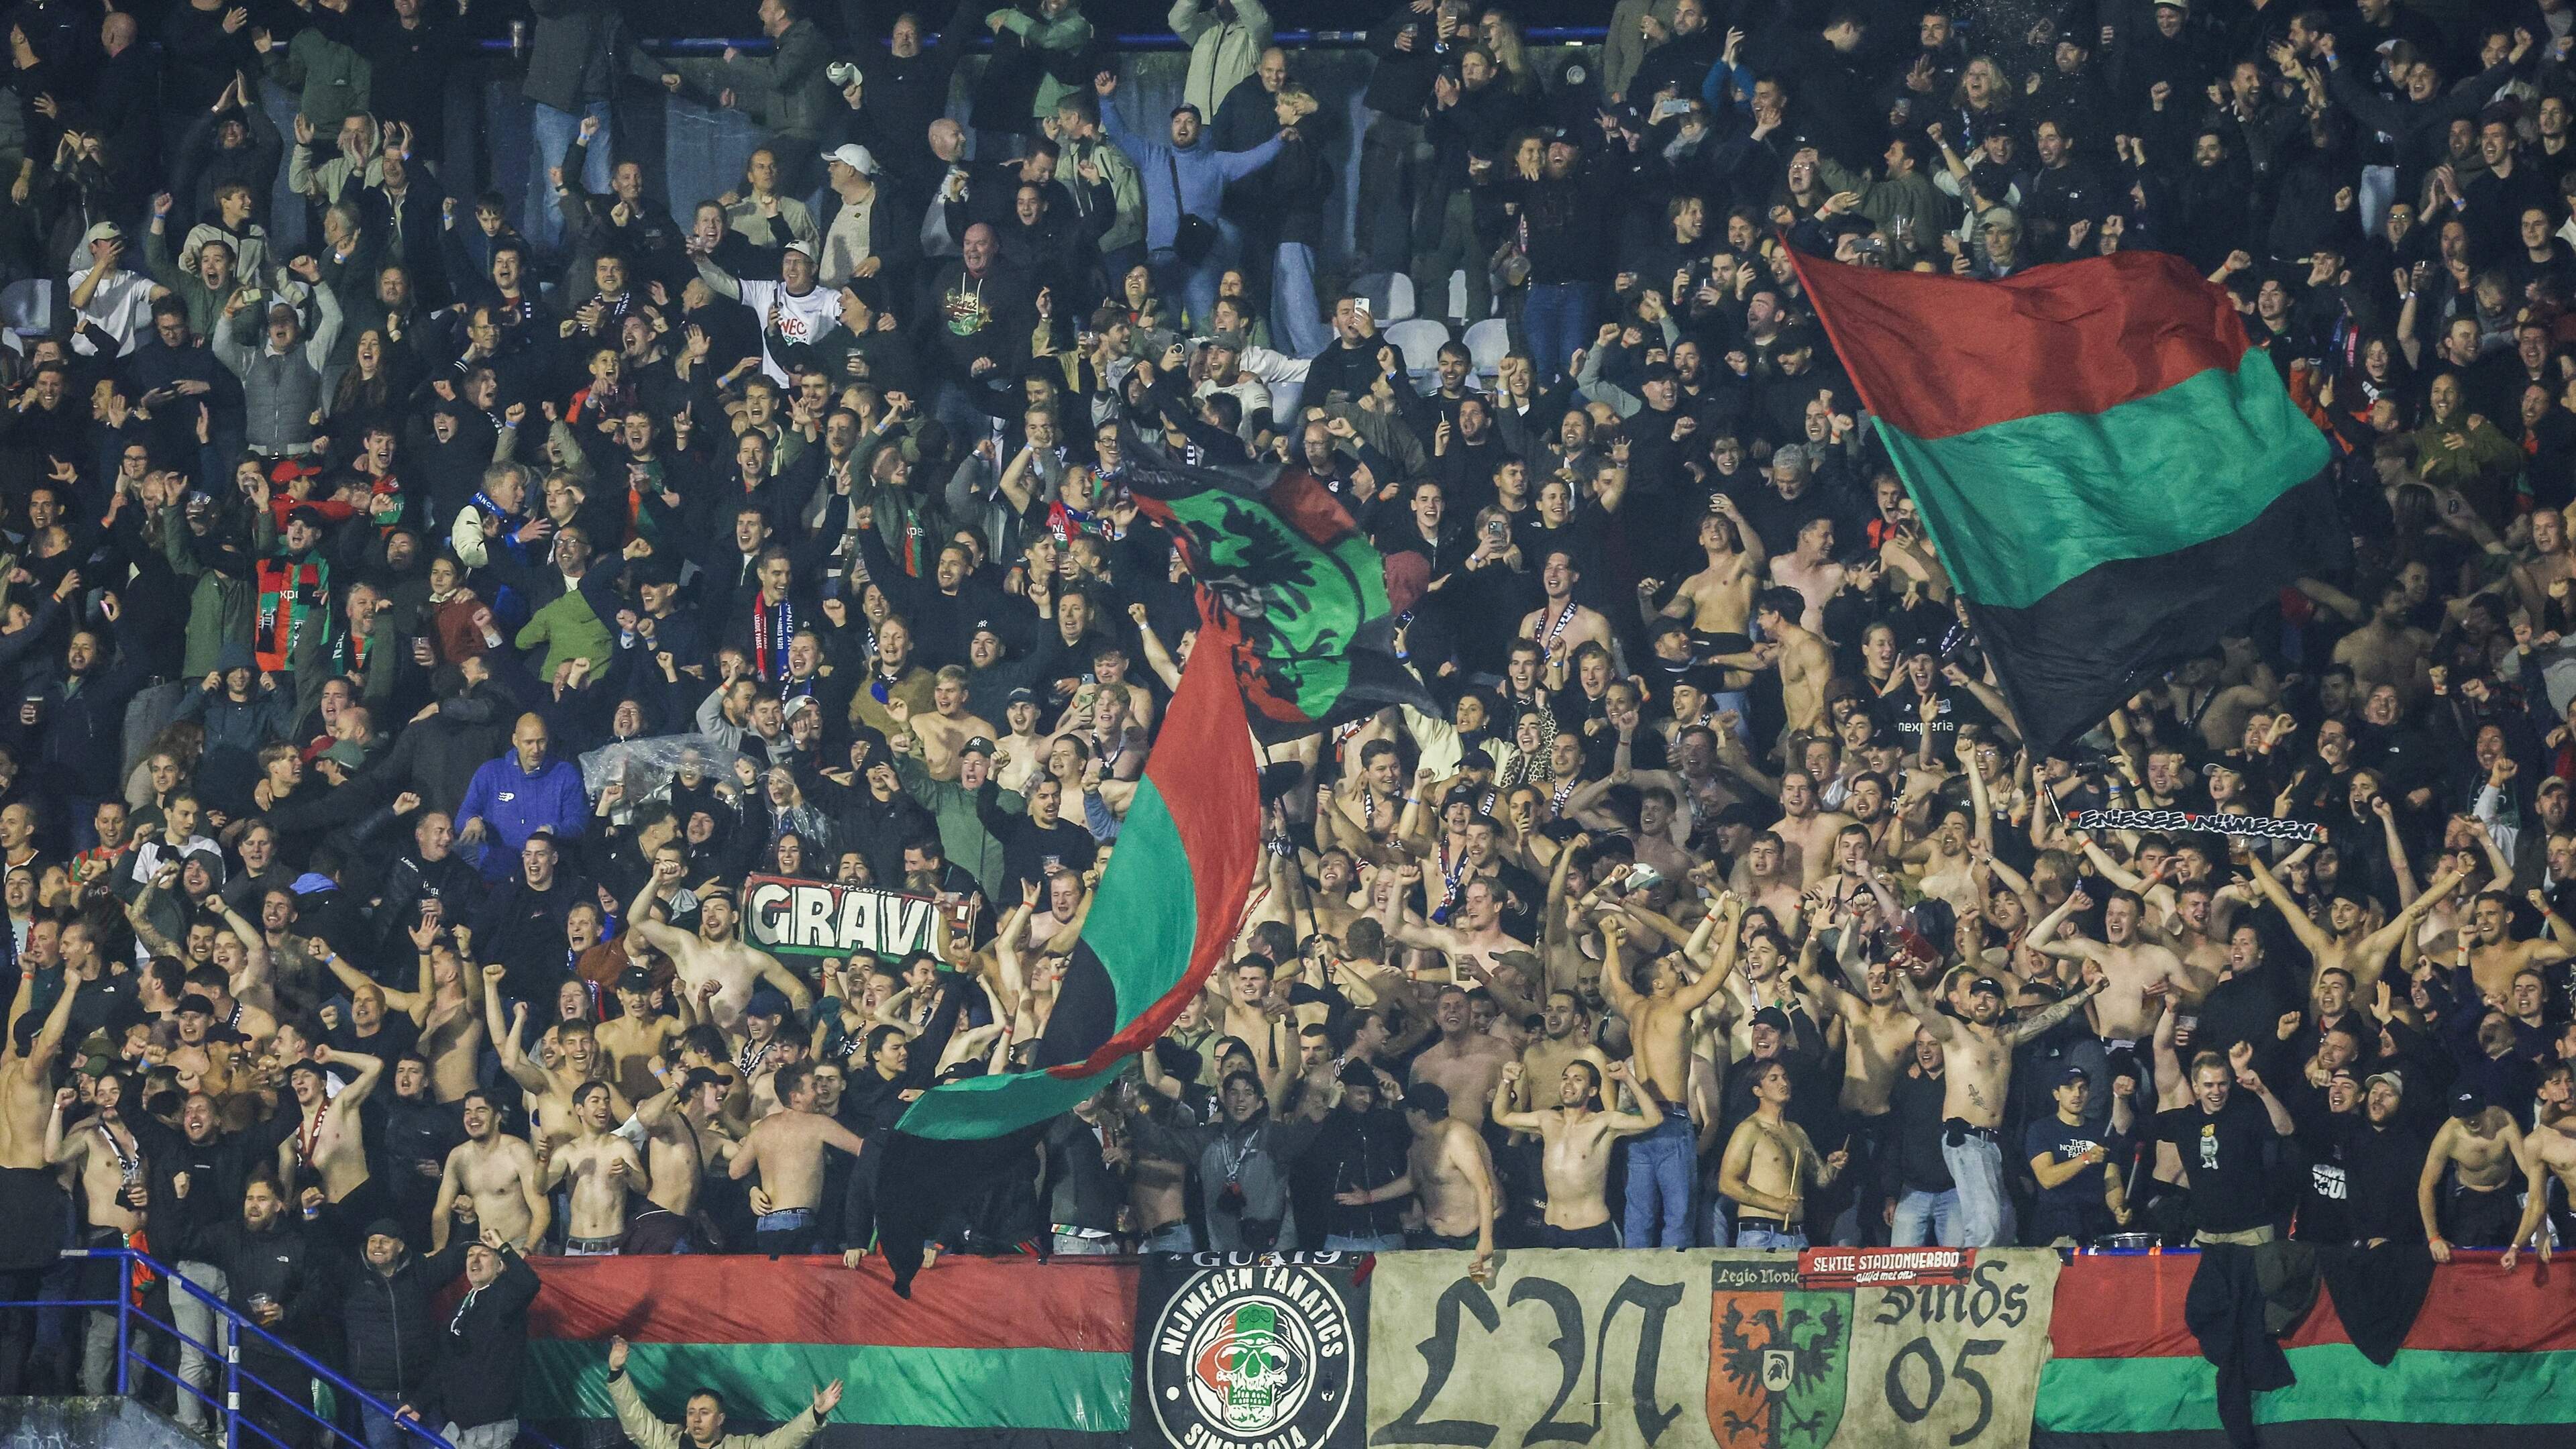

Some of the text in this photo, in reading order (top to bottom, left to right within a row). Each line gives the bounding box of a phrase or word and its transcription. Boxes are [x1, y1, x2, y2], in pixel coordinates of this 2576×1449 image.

[780, 318, 807, 335] NEC
[2059, 1144, 2088, 1152] NORTH
[2070, 1138, 2087, 1146] THE
[1813, 1256, 1856, 1272] SEKTIE
[1717, 1267, 1758, 1287] Legio
[1161, 1267, 1344, 1358] NIJMEGEN FANATICS
[1884, 1336, 2006, 1447] 05
